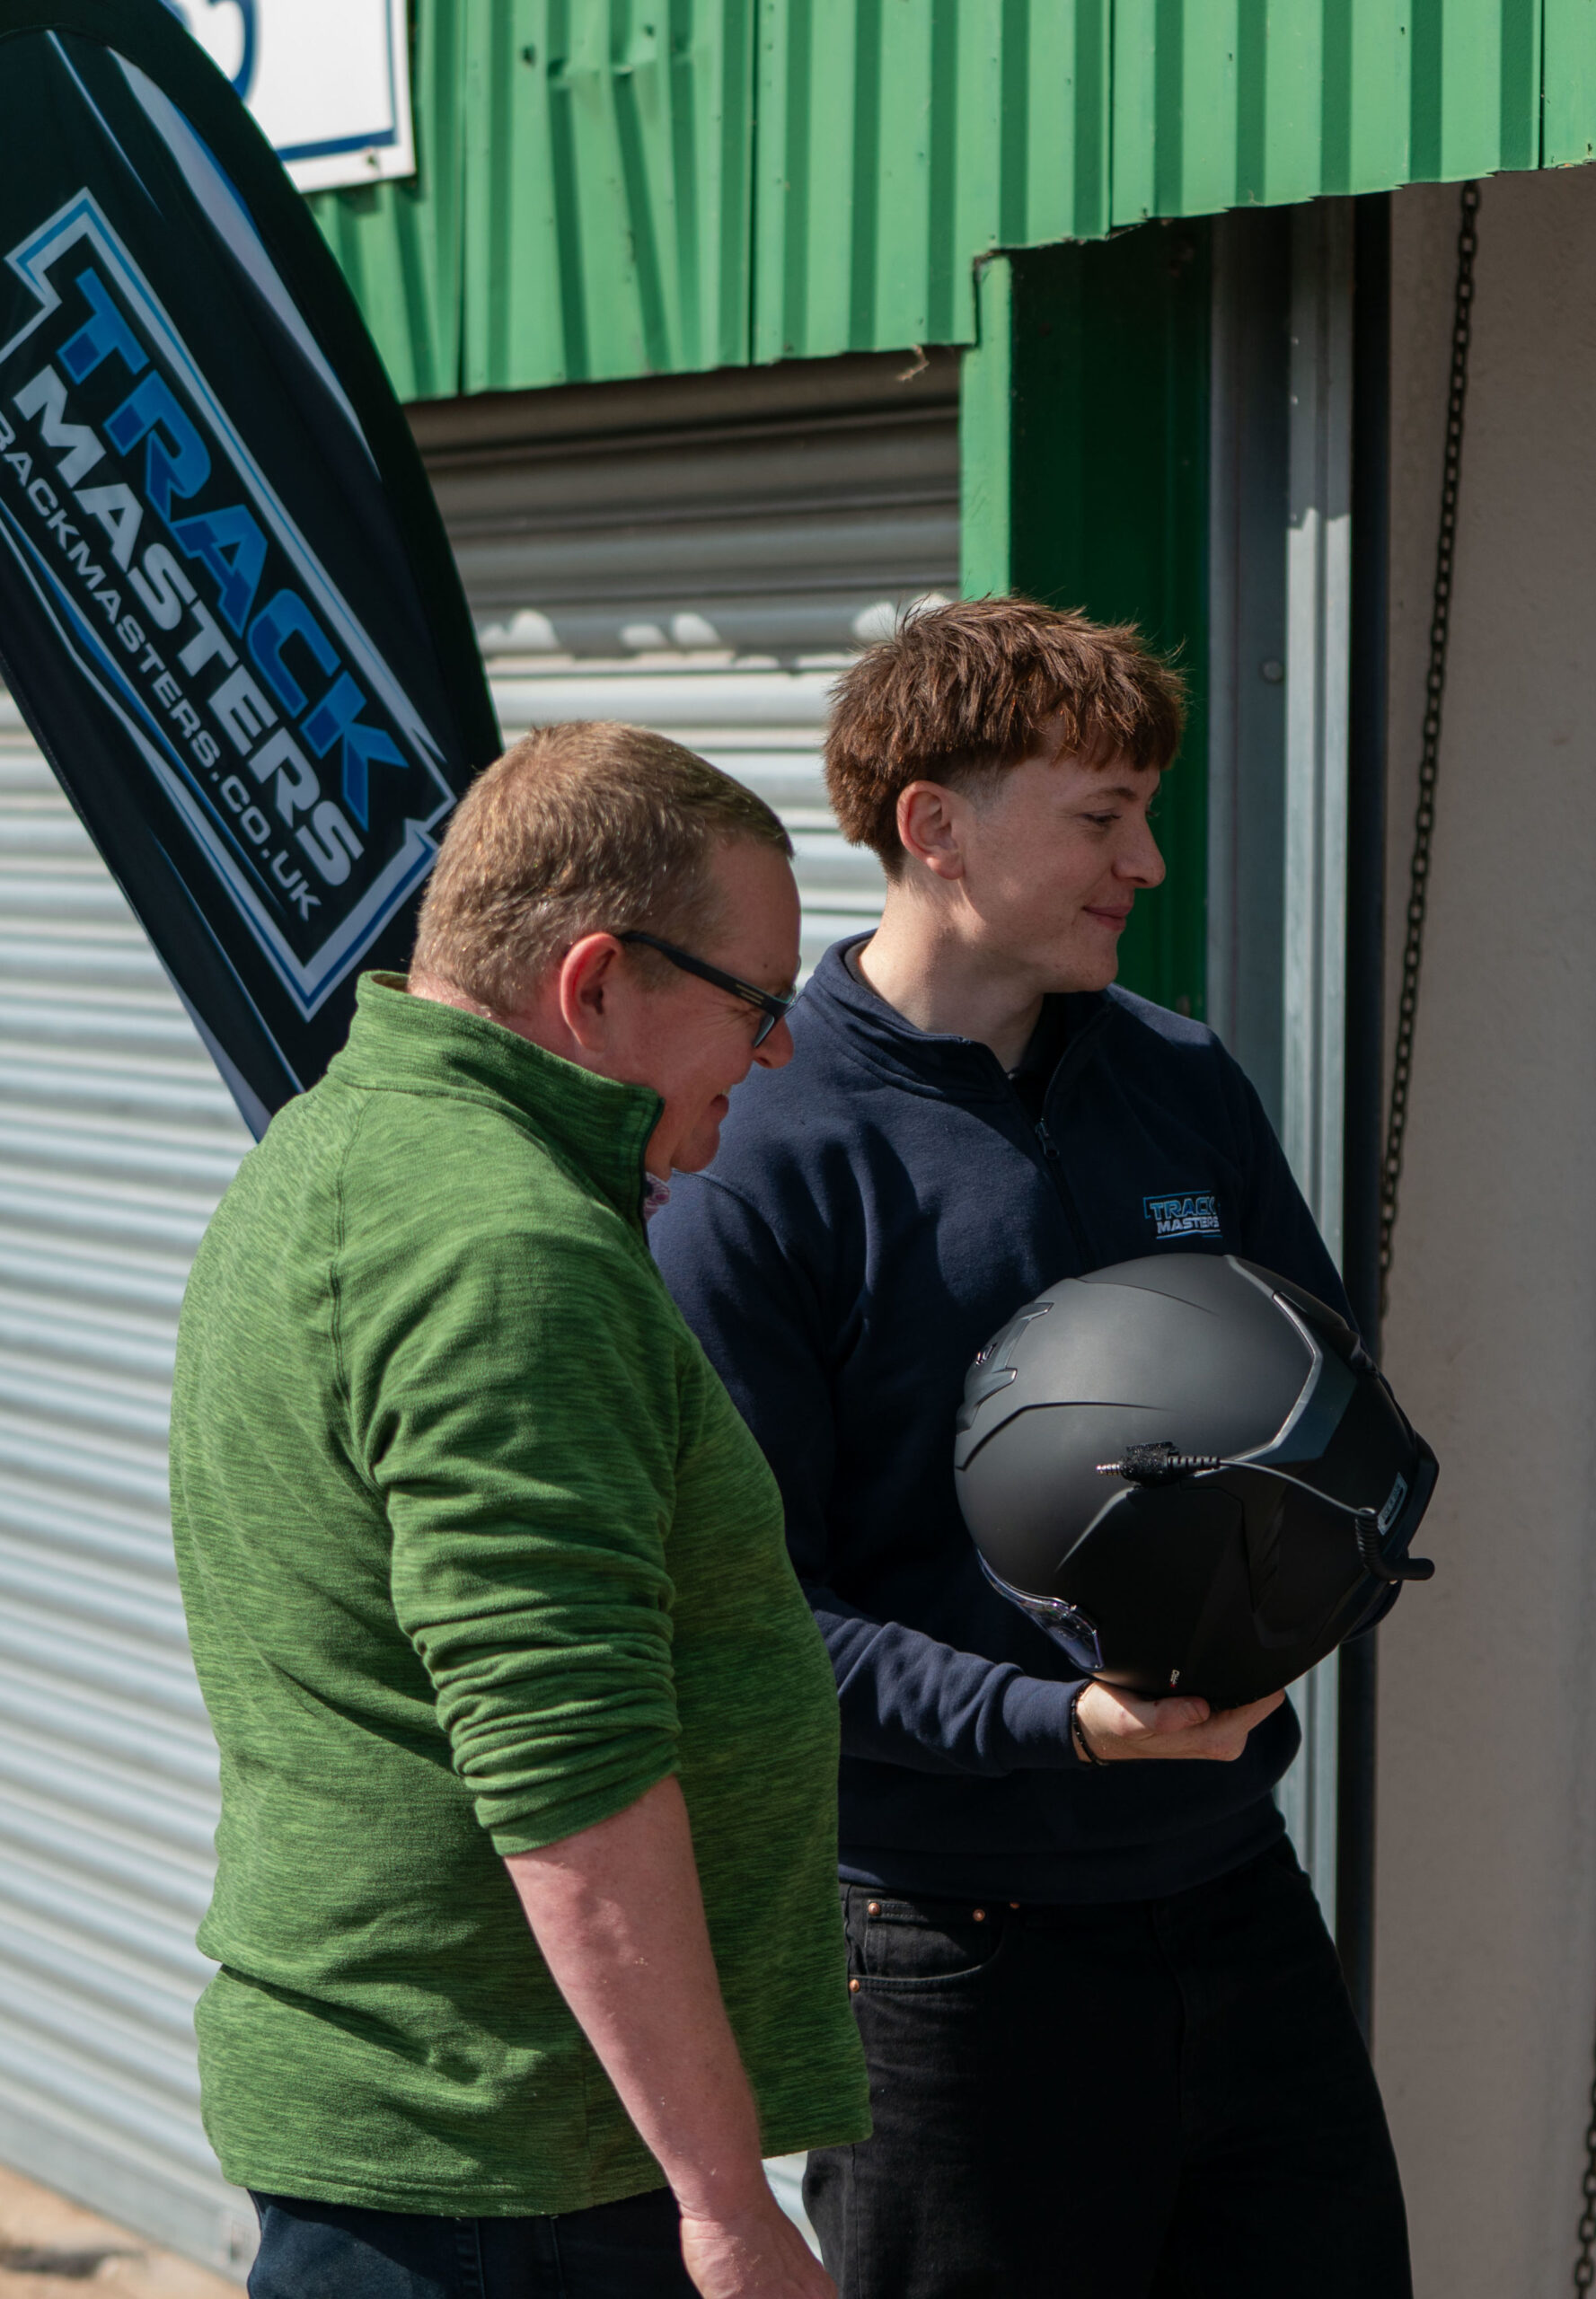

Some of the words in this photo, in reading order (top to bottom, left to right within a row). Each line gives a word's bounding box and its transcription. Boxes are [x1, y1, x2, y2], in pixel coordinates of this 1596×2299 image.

[13, 364, 365, 887] MASTERS
[56, 267, 410, 832] TRACK
[1150, 1196, 1216, 1220] TRACK
[1157, 1216, 1220, 1234] MASTERS
